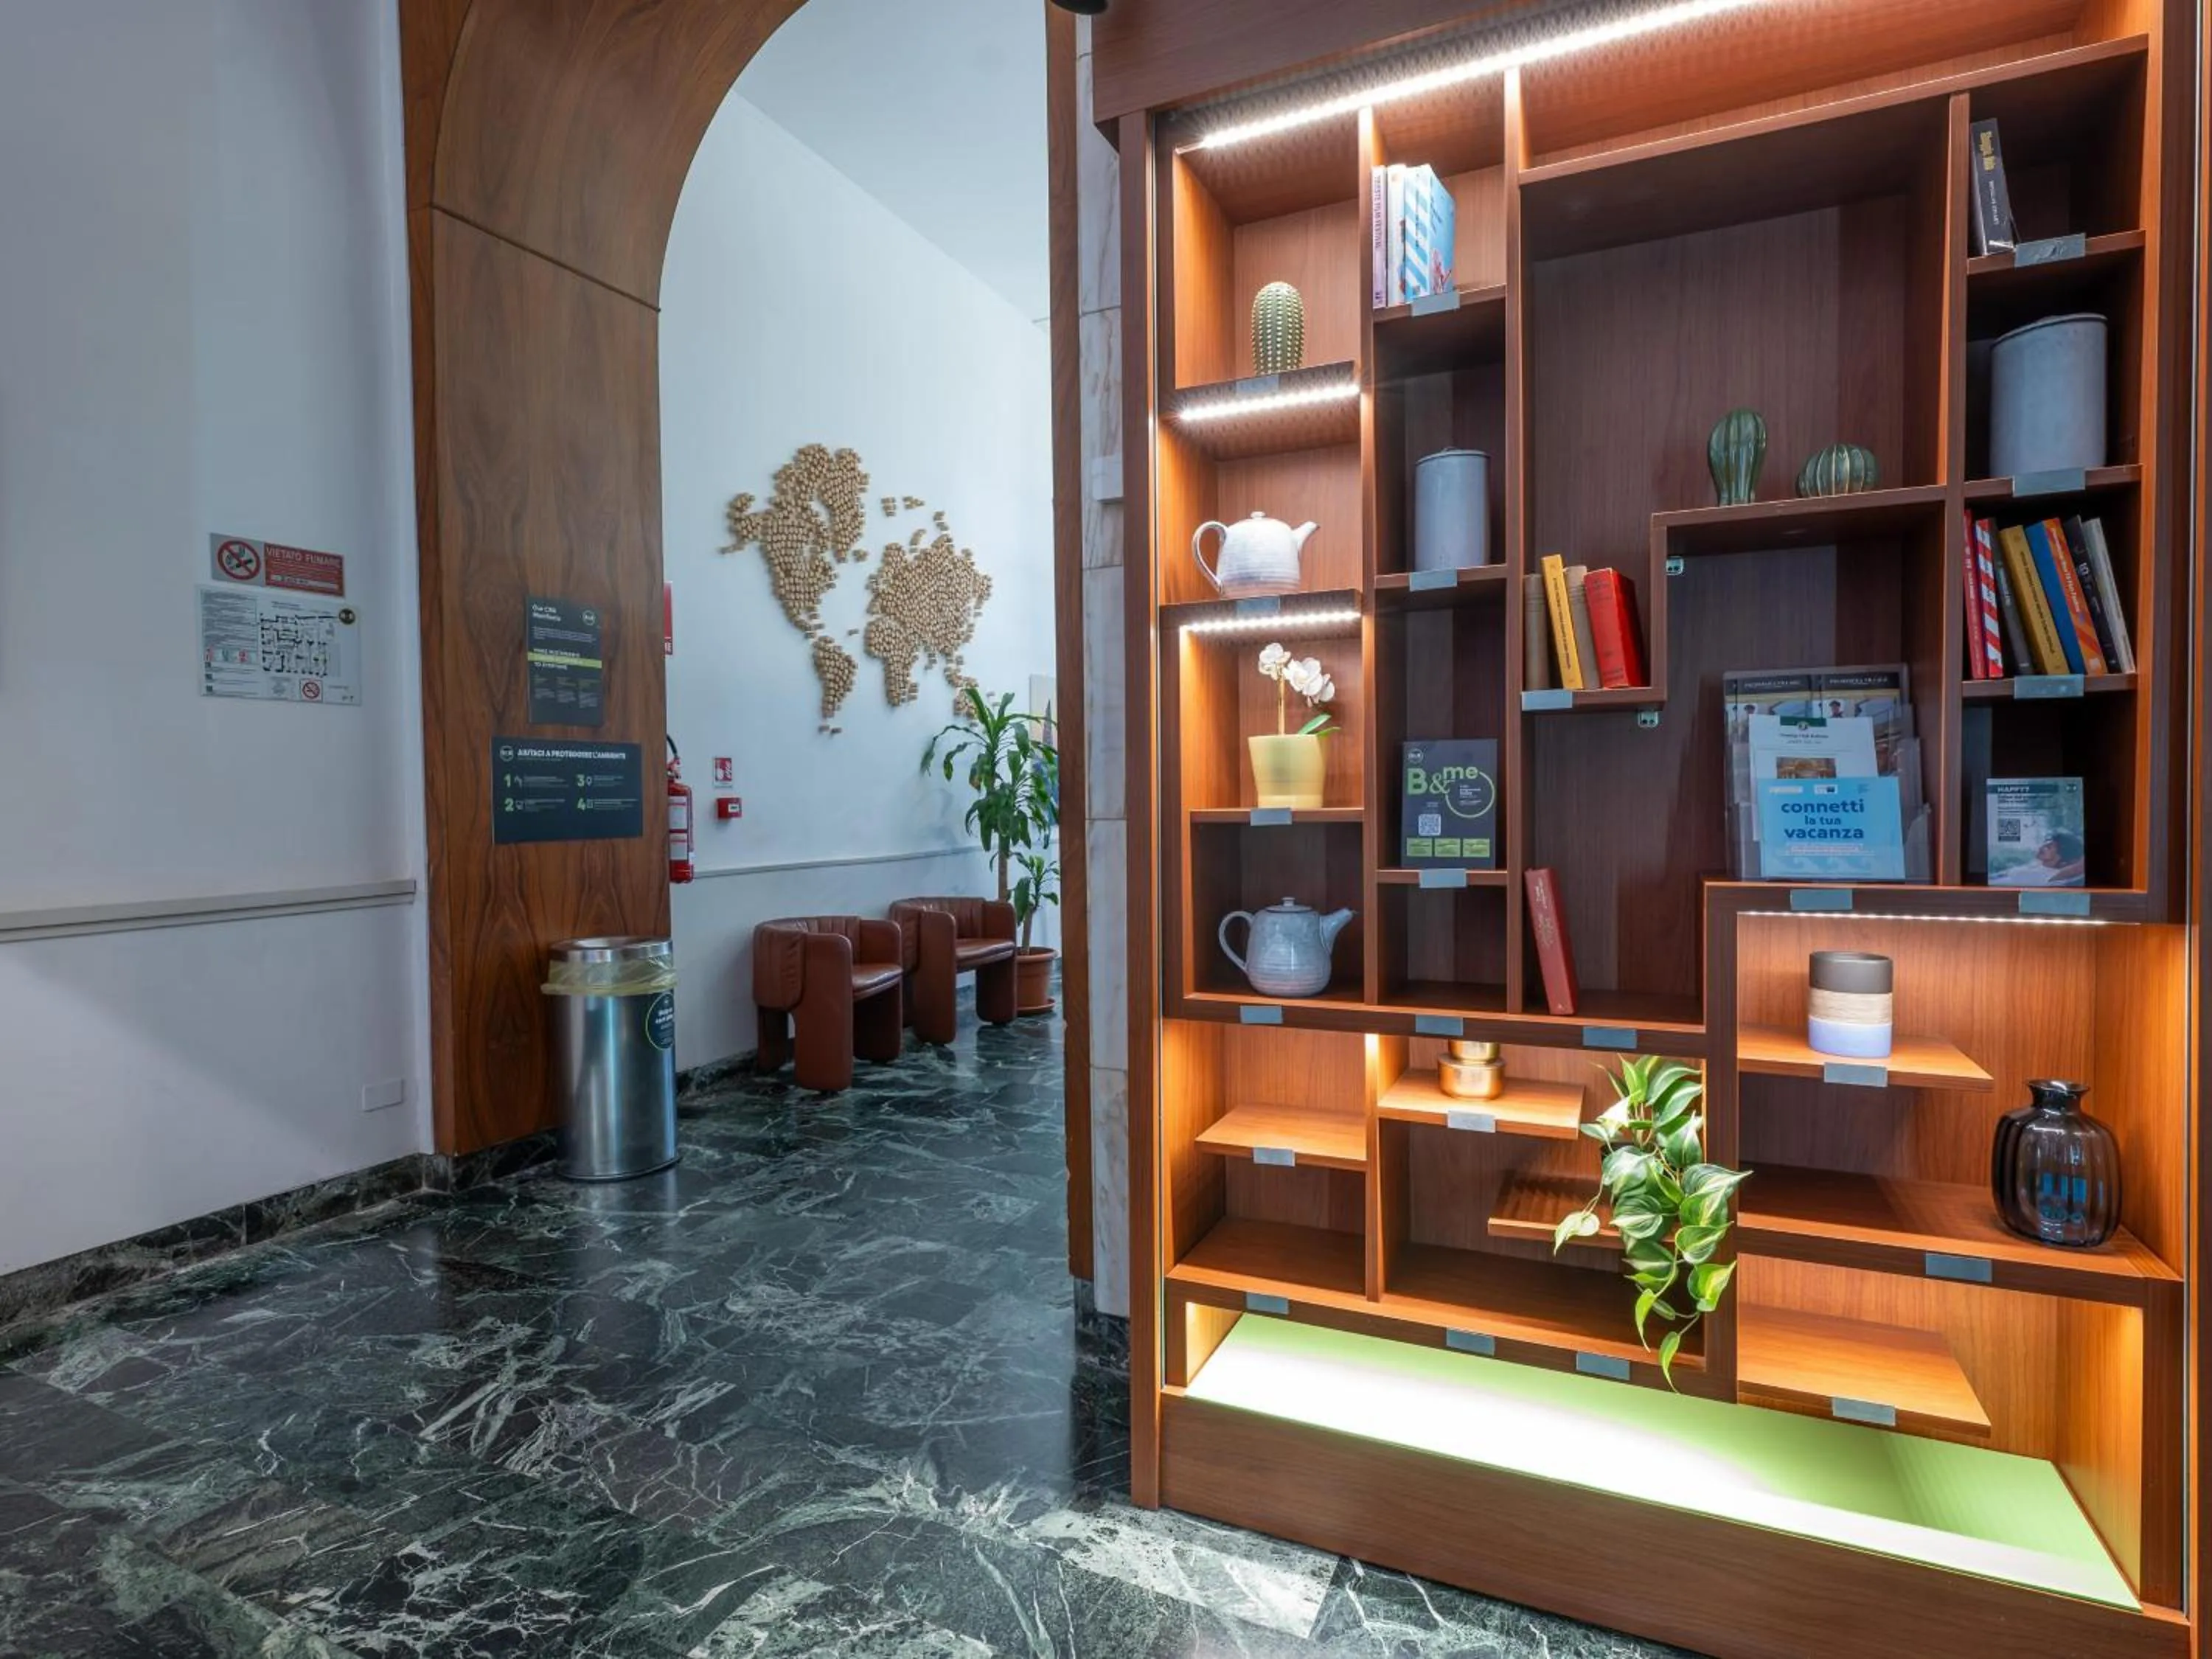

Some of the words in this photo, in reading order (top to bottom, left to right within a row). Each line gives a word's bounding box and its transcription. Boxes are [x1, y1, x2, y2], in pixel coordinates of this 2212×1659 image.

[266, 546, 302, 561] VIETATO
[504, 774, 512, 787] 1
[577, 774, 585, 787] 3
[504, 799, 514, 811] 2
[577, 799, 586, 810] 4
[1781, 799, 1864, 813] connetti
[1805, 815, 1816, 825] la
[1820, 815, 1841, 825] tua
[1784, 827, 1864, 839] vacanza
